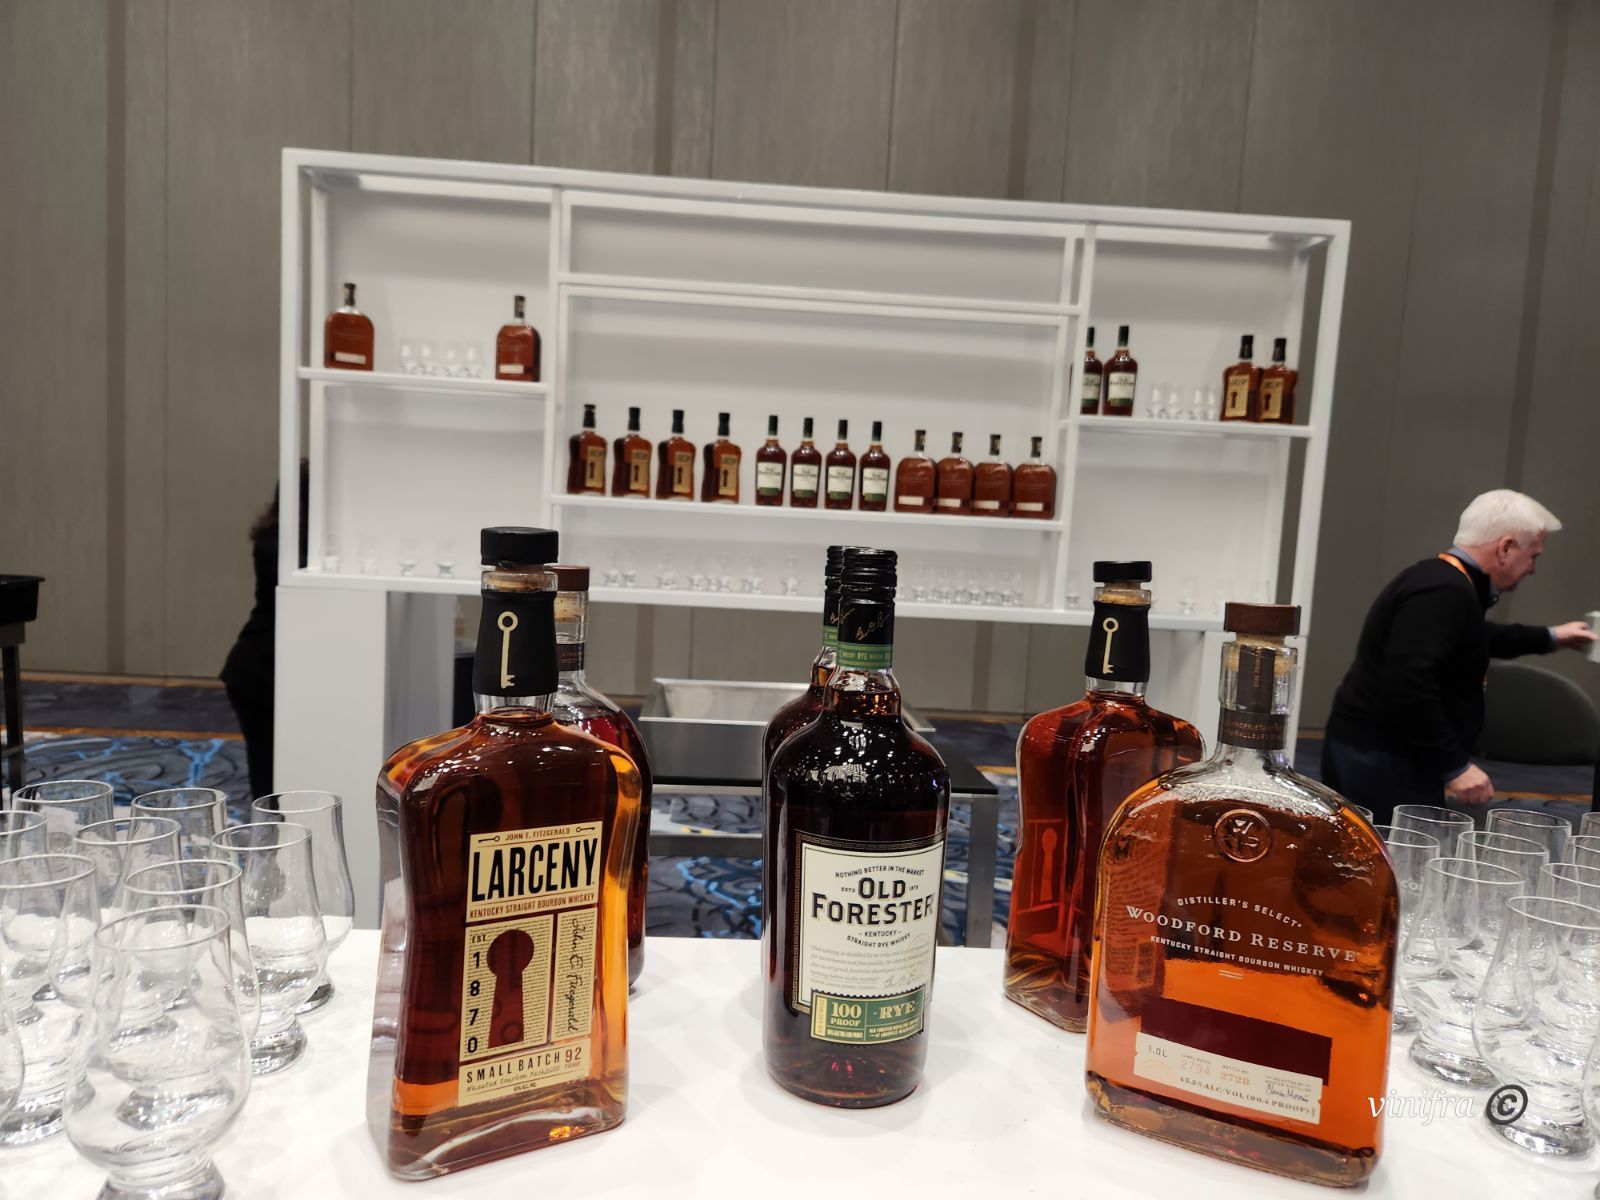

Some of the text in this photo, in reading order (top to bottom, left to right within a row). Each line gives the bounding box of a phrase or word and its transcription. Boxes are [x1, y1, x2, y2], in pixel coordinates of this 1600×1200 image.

[505, 832, 523, 841] JOHN
[532, 827, 571, 838] FITZGERALD
[471, 838, 598, 902] LARCENY
[835, 868, 862, 878] NOTHING
[864, 866, 887, 874] BETTER
[906, 868, 924, 876] MARKET
[858, 878, 906, 898] OLD
[470, 893, 594, 919] KENTUCKY STRAIGHT BOURBON WHISKEY
[811, 892, 934, 925] FORESTER
[1177, 896, 1299, 928] DISTILLER'S SELECT
[846, 935, 876, 948] STRAIGHT
[890, 933, 911, 947] WHISKY
[864, 930, 898, 938] KENTUCKY
[1126, 905, 1356, 962] WOODFORD RESERVE
[1151, 935, 1324, 977] KENTUCKY STRAIGHT BOURBON WHISKEY
[831, 1002, 862, 1018] 100
[879, 1000, 915, 1020] RYE
[830, 1018, 861, 1026] PROOF
[466, 1047, 582, 1084] SMALL BATCH 92
